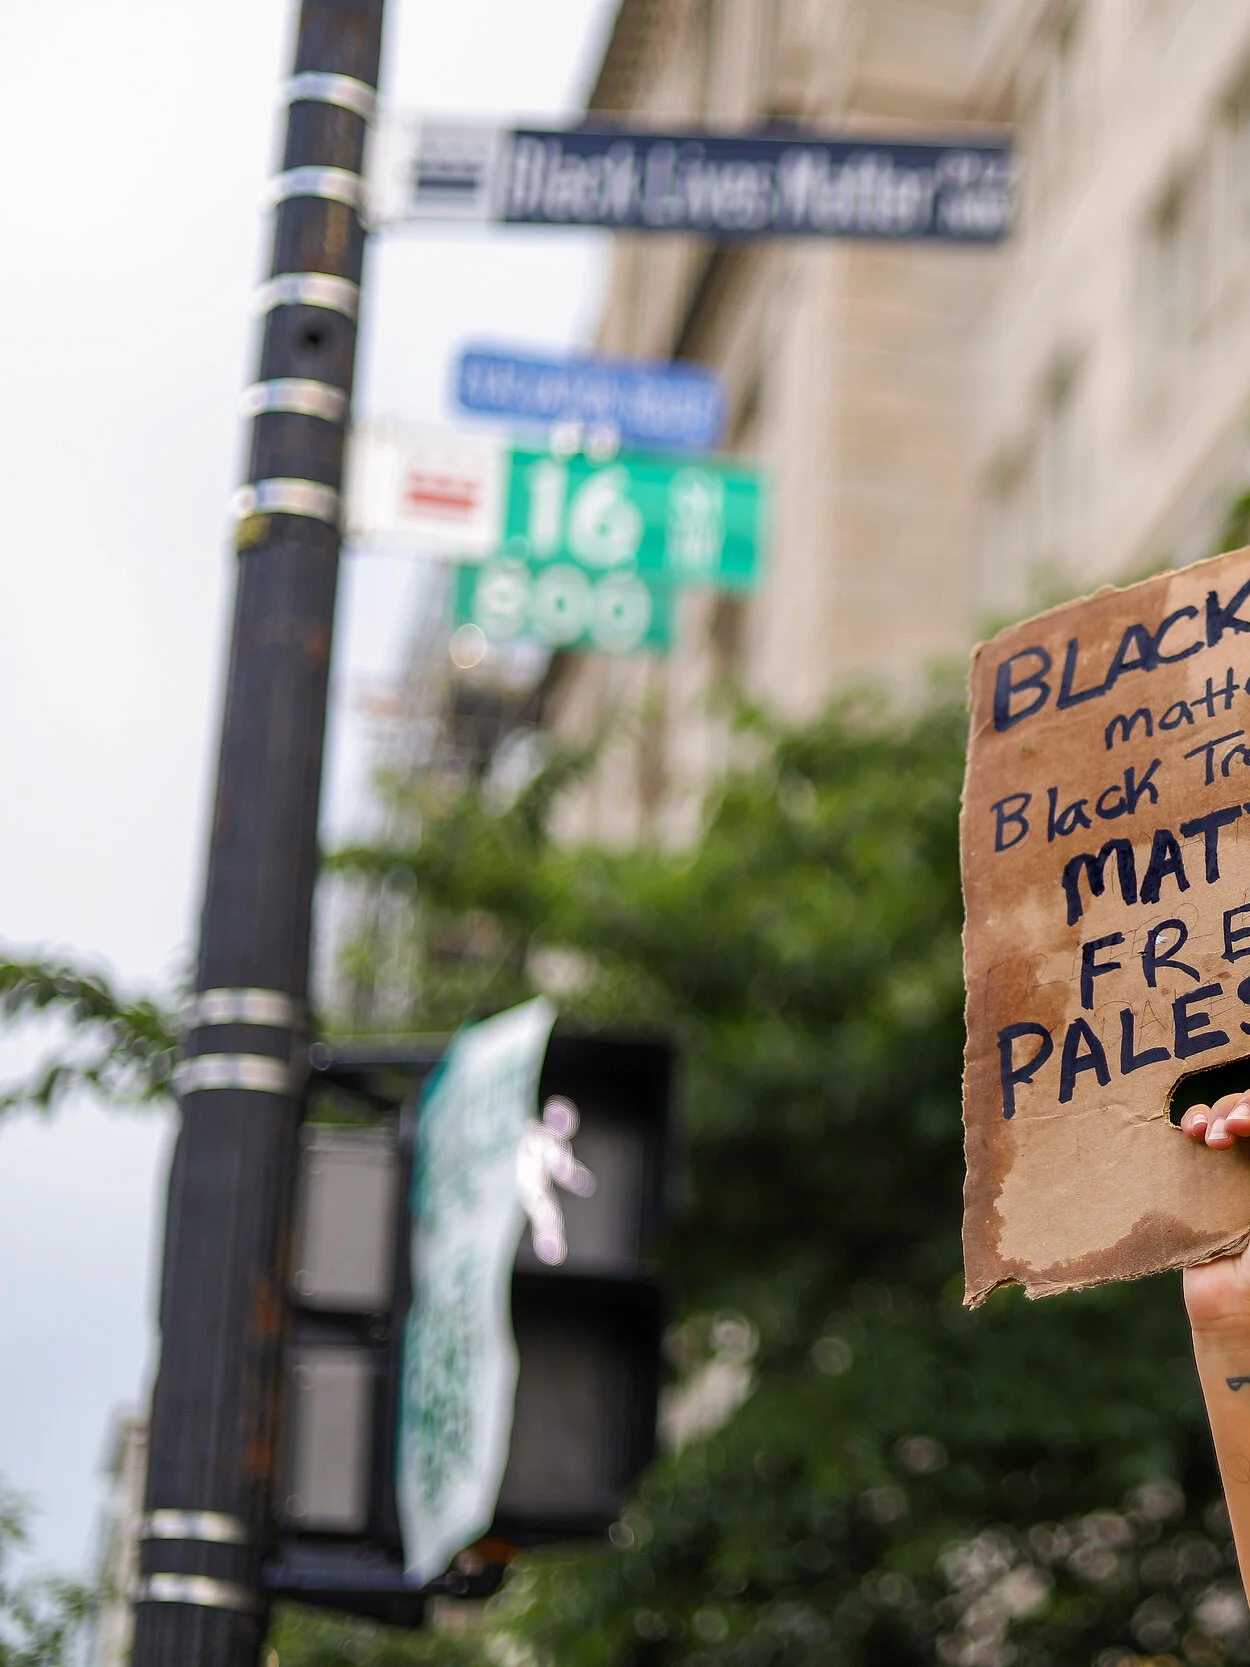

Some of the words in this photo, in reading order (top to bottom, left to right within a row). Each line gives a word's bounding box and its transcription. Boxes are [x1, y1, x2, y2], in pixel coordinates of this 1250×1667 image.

[508, 137, 643, 222] Black
[644, 140, 776, 228] Lives
[526, 460, 644, 570] 16
[991, 758, 1161, 852] Black
